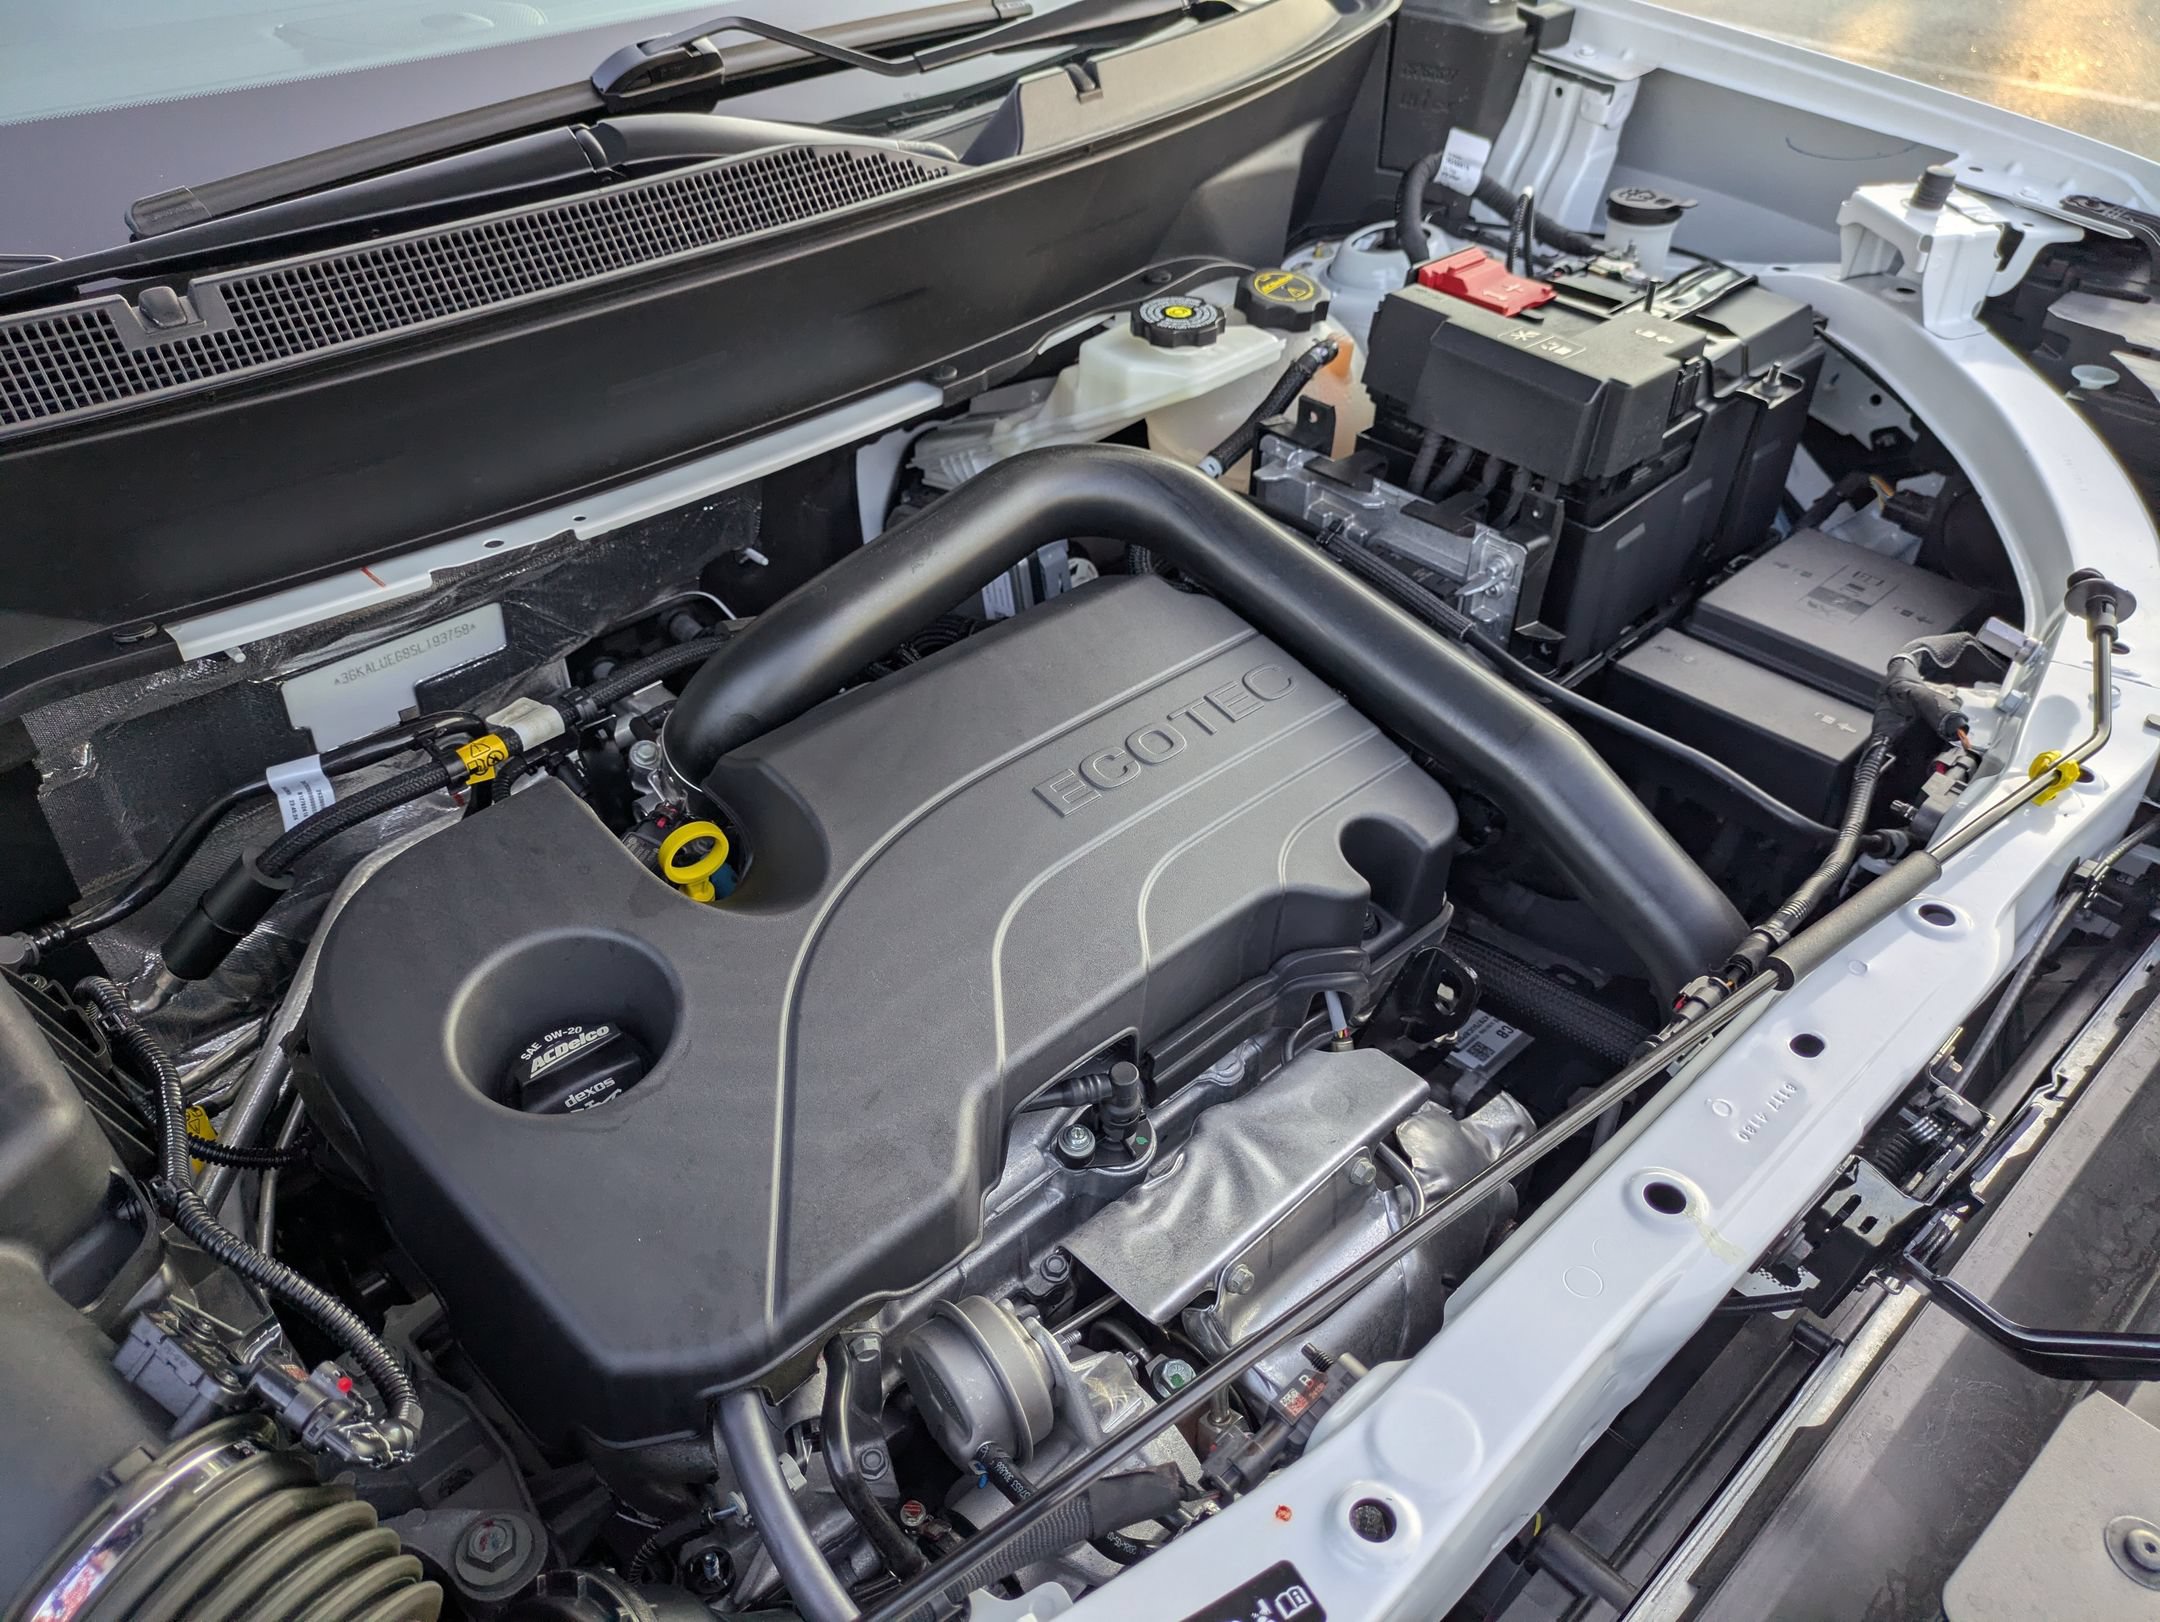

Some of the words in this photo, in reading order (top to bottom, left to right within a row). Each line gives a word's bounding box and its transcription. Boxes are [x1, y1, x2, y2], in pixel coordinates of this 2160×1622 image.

[1032, 663, 1298, 818] ECOTEC
[521, 1041, 542, 1061] SAE
[544, 1026, 583, 1042] 0W-20
[531, 1025, 610, 1074] ACDelco
[564, 1077, 616, 1108] dexos
